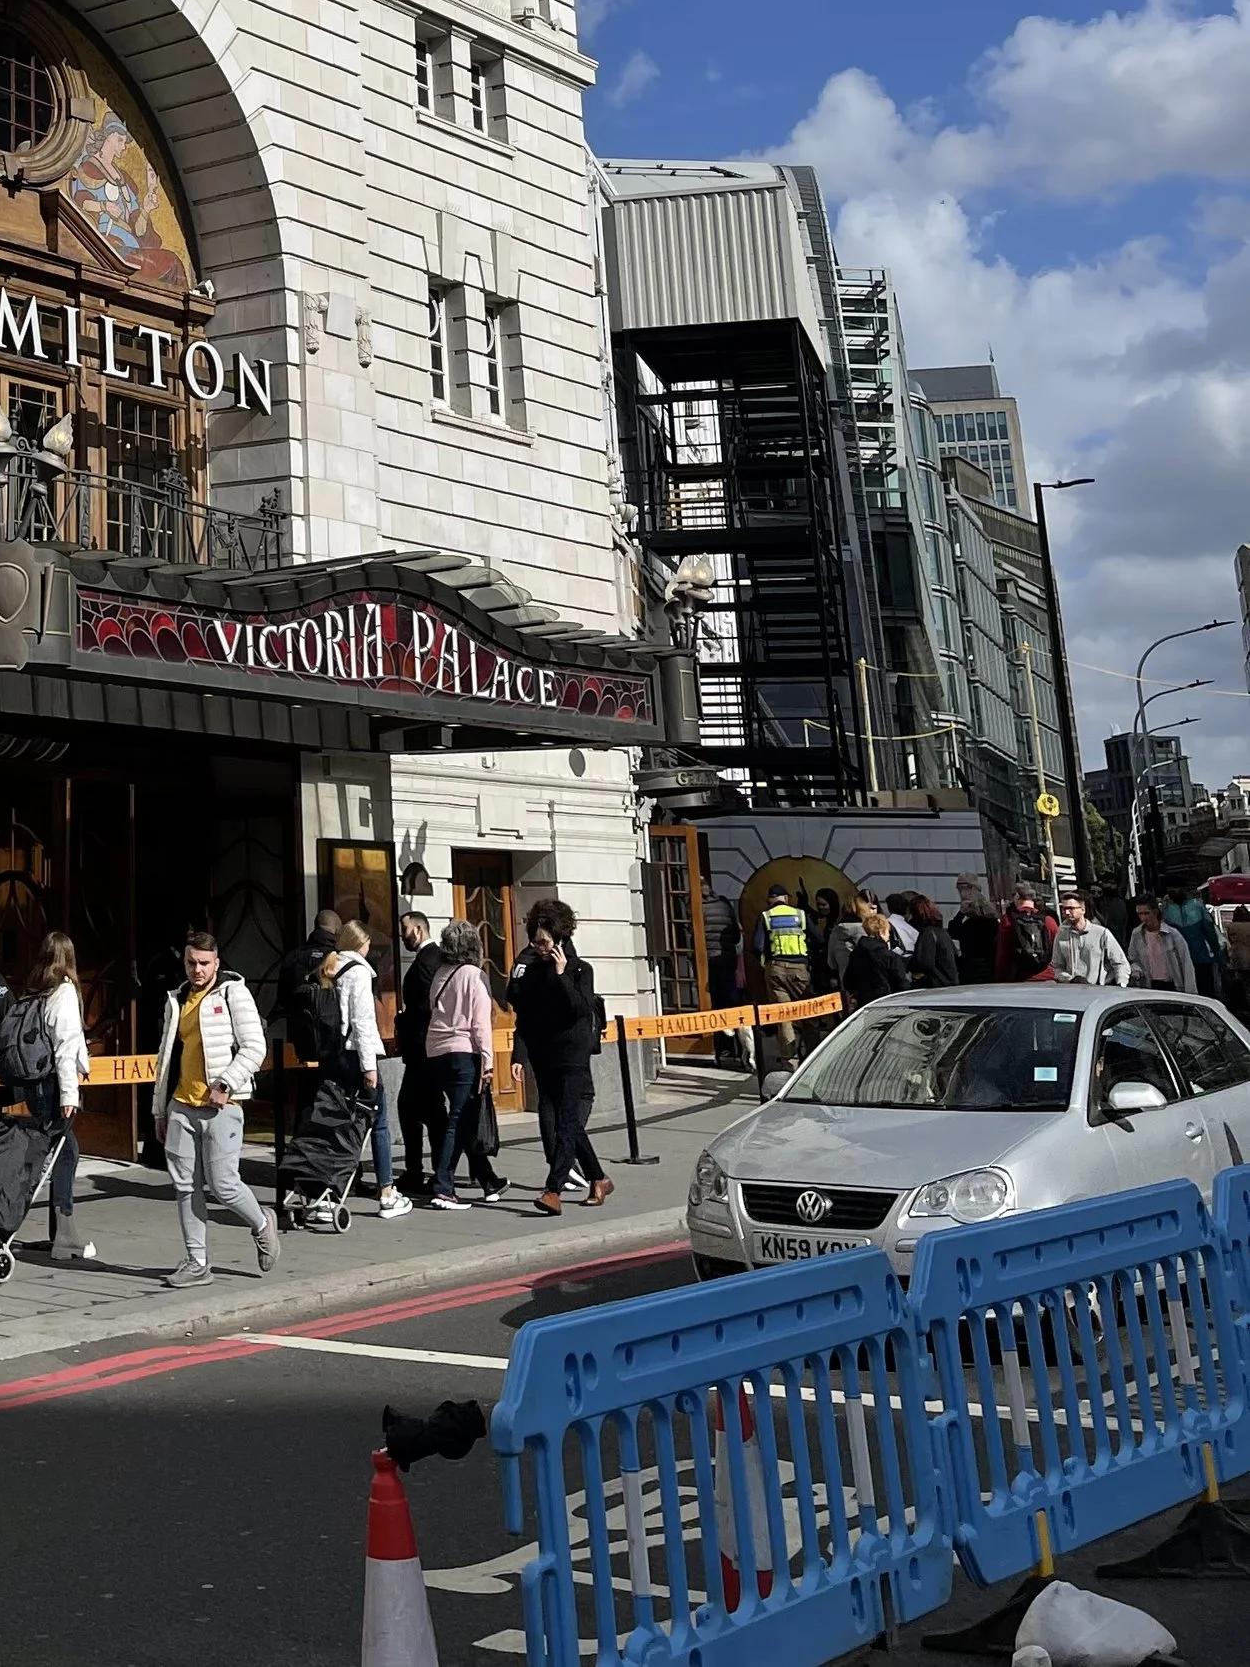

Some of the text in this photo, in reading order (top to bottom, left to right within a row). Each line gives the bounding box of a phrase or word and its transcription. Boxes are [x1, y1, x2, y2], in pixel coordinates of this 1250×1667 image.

[213, 603, 558, 707] VICTORIA PALACE
[655, 1012, 728, 1035] HAMILTON
[760, 1235, 812, 1261] KN59
